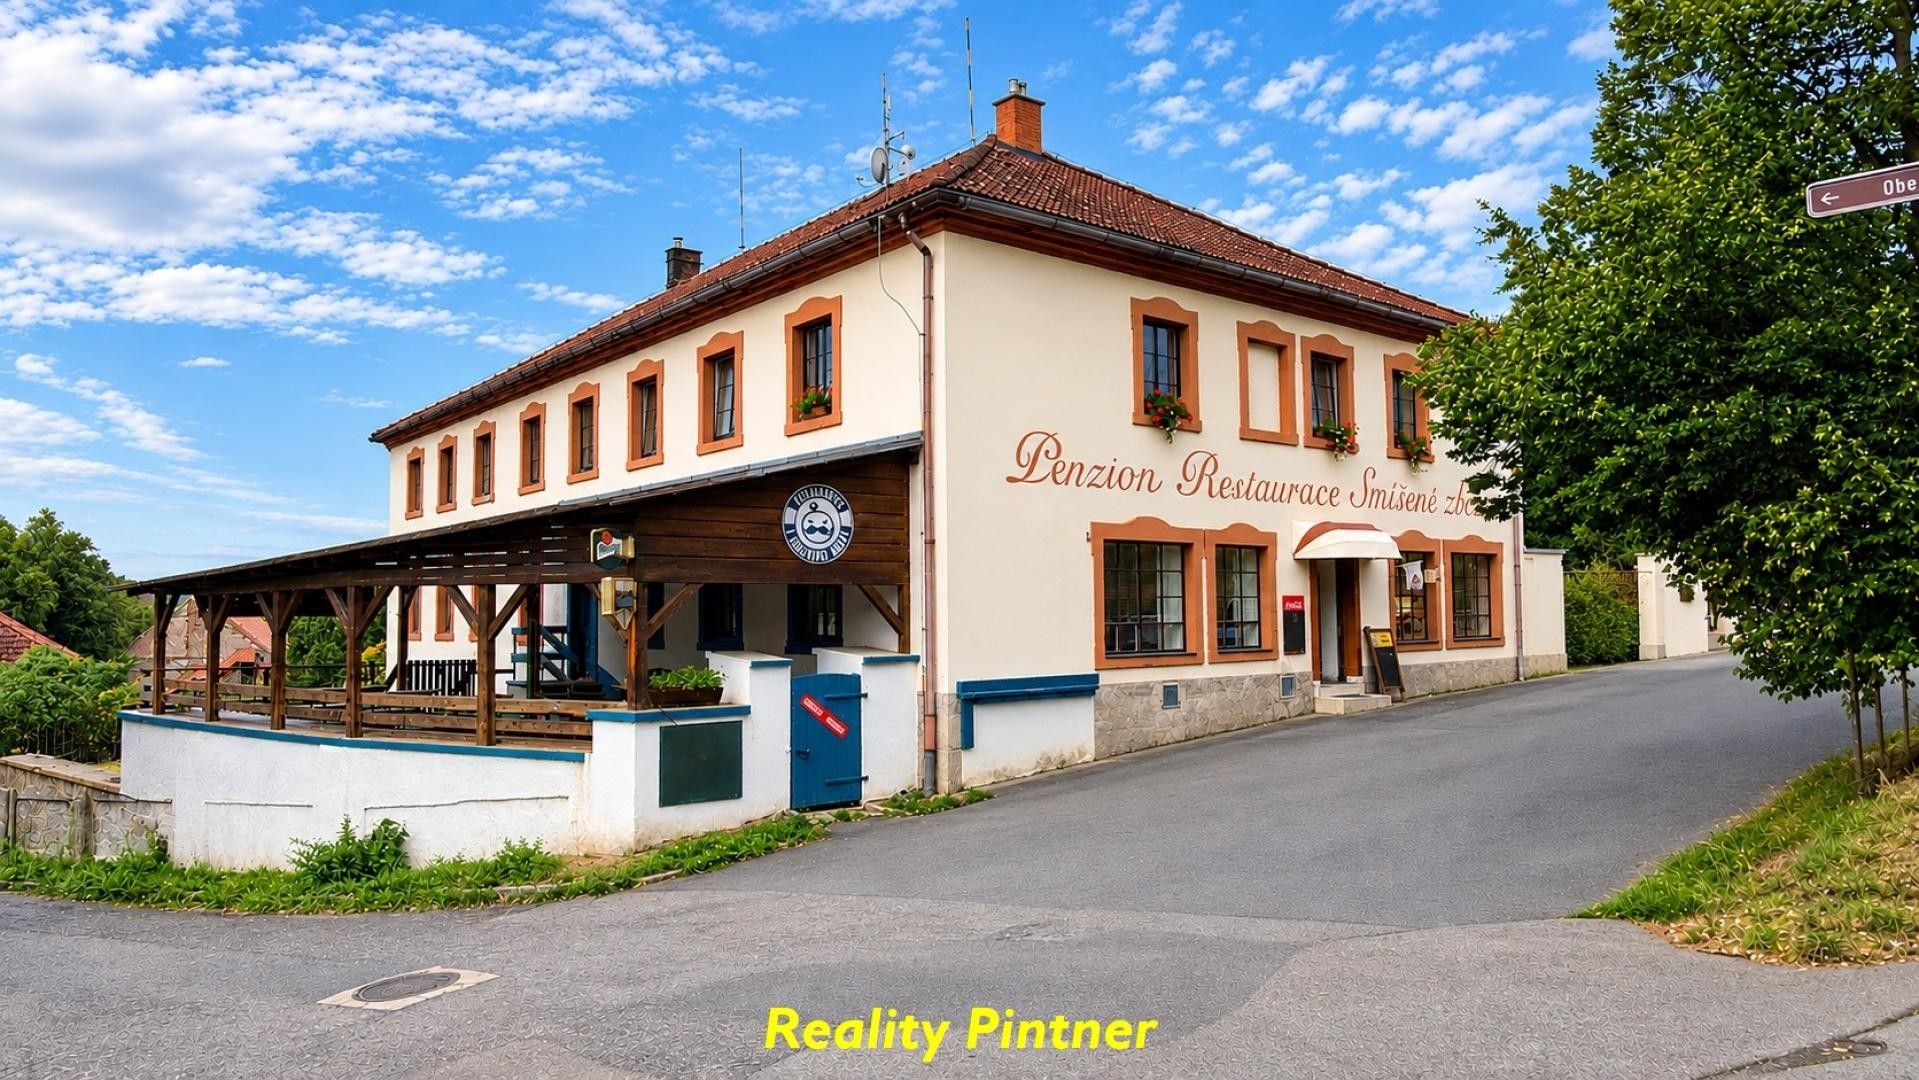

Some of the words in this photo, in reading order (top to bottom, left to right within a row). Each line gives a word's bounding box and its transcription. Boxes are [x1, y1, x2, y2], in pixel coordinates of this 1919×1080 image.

[1883, 178, 1917, 196] Obe
[1006, 431, 1163, 493] Penzion
[1176, 450, 1341, 508] Restaurace
[1349, 466, 1437, 515] Smíšené
[1443, 479, 1484, 517] zbo
